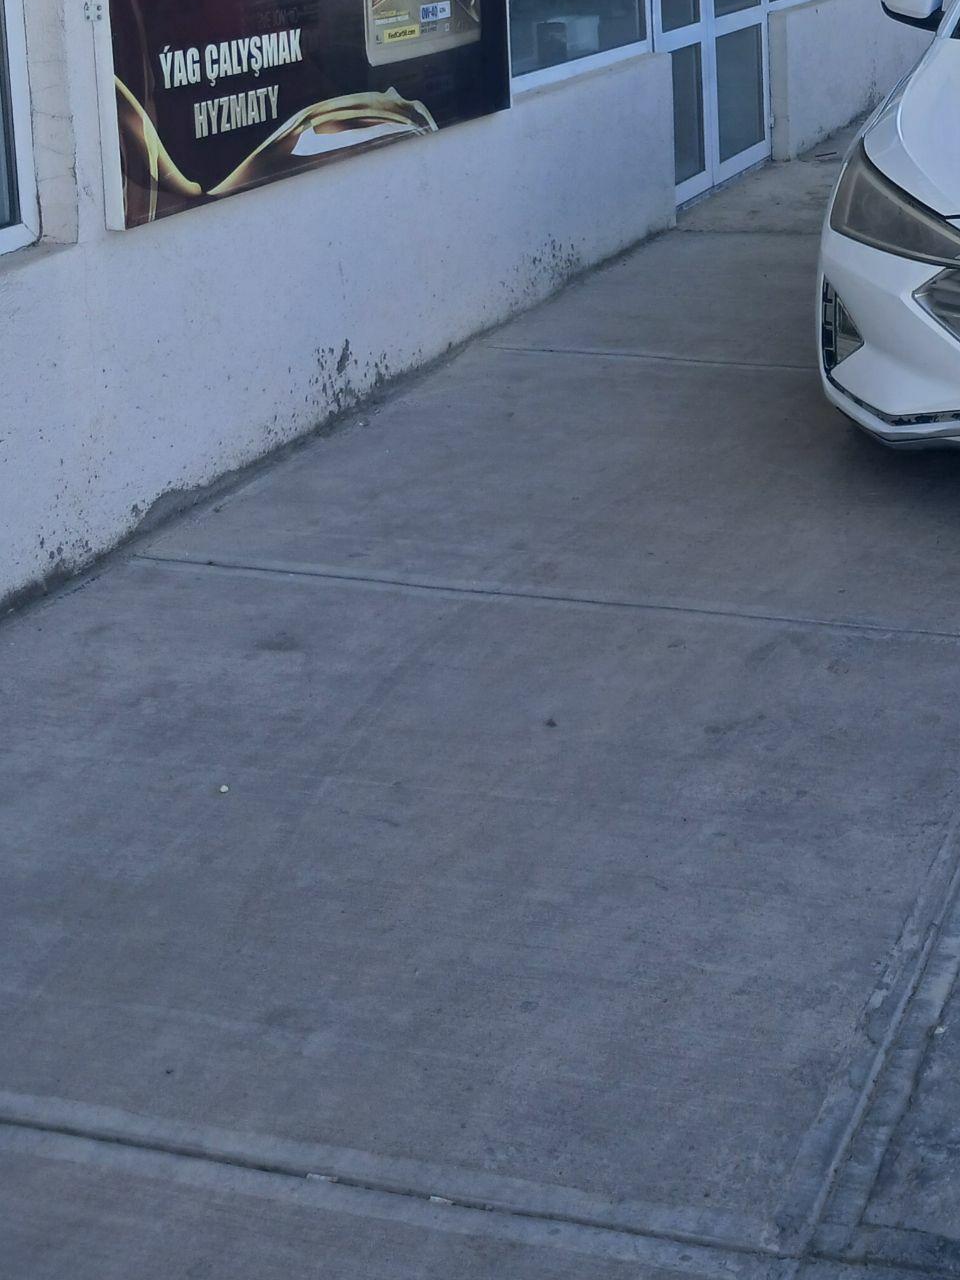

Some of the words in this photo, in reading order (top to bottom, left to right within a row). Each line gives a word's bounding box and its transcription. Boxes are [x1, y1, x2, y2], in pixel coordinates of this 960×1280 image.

[159, 45, 201, 89] ÝAG
[204, 28, 303, 87] ÇALYŞMAK
[193, 84, 279, 139] HYZMATY
